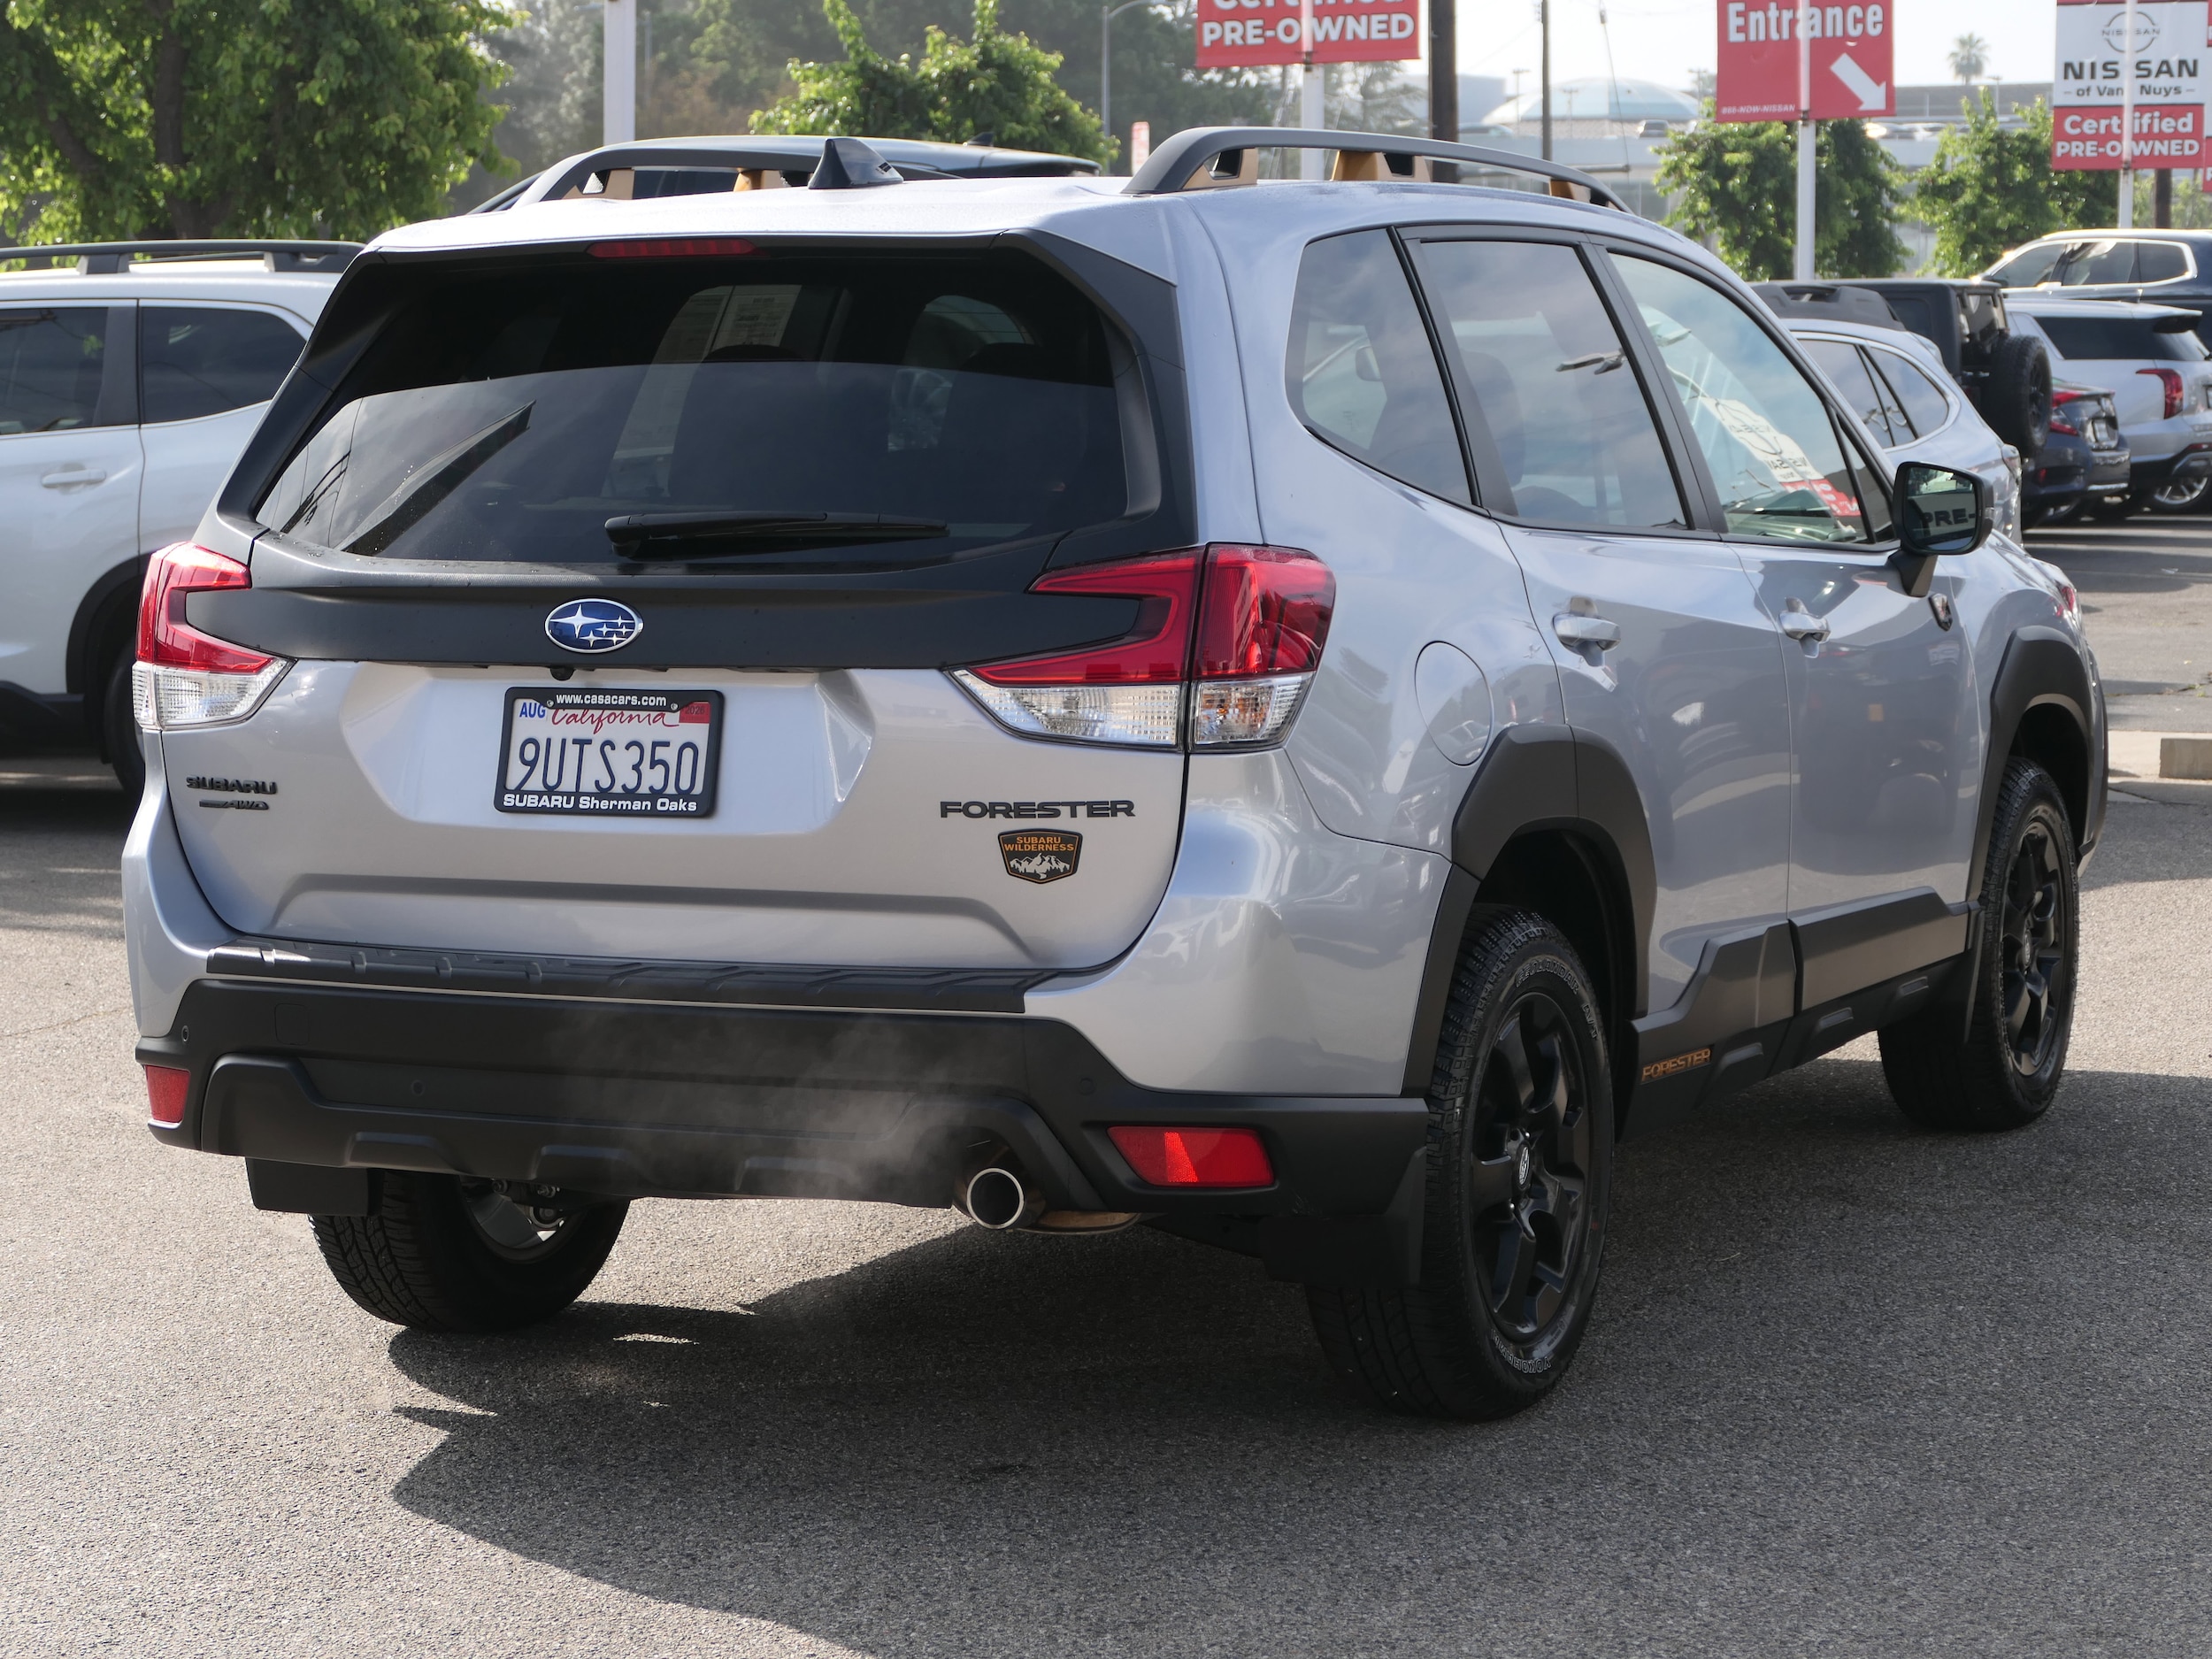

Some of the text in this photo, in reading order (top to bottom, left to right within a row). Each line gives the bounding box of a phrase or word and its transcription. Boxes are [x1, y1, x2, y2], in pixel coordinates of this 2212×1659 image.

[1202, 12, 1415, 47] PRE-OWNED
[1727, 2, 1884, 42] Entrance
[2063, 58, 2199, 81] NISSAN
[2076, 84, 2182, 97] of Van Nuys
[2063, 111, 2194, 135] Certified
[2055, 138, 2200, 157] PRE-OWNED
[518, 702, 547, 718] AUG
[556, 693, 667, 707] www.casacars.com
[551, 708, 680, 735] California
[514, 737, 699, 795] 9UTS350
[186, 776, 279, 795] SUBARU
[228, 799, 270, 810] AWD
[503, 793, 697, 811] SUBARU Sherman Oaks
[940, 800, 1136, 818] FORESTER
[1641, 1047, 1712, 1082] FORESTER
[1491, 1330, 1552, 1374] YOKOHAMA
